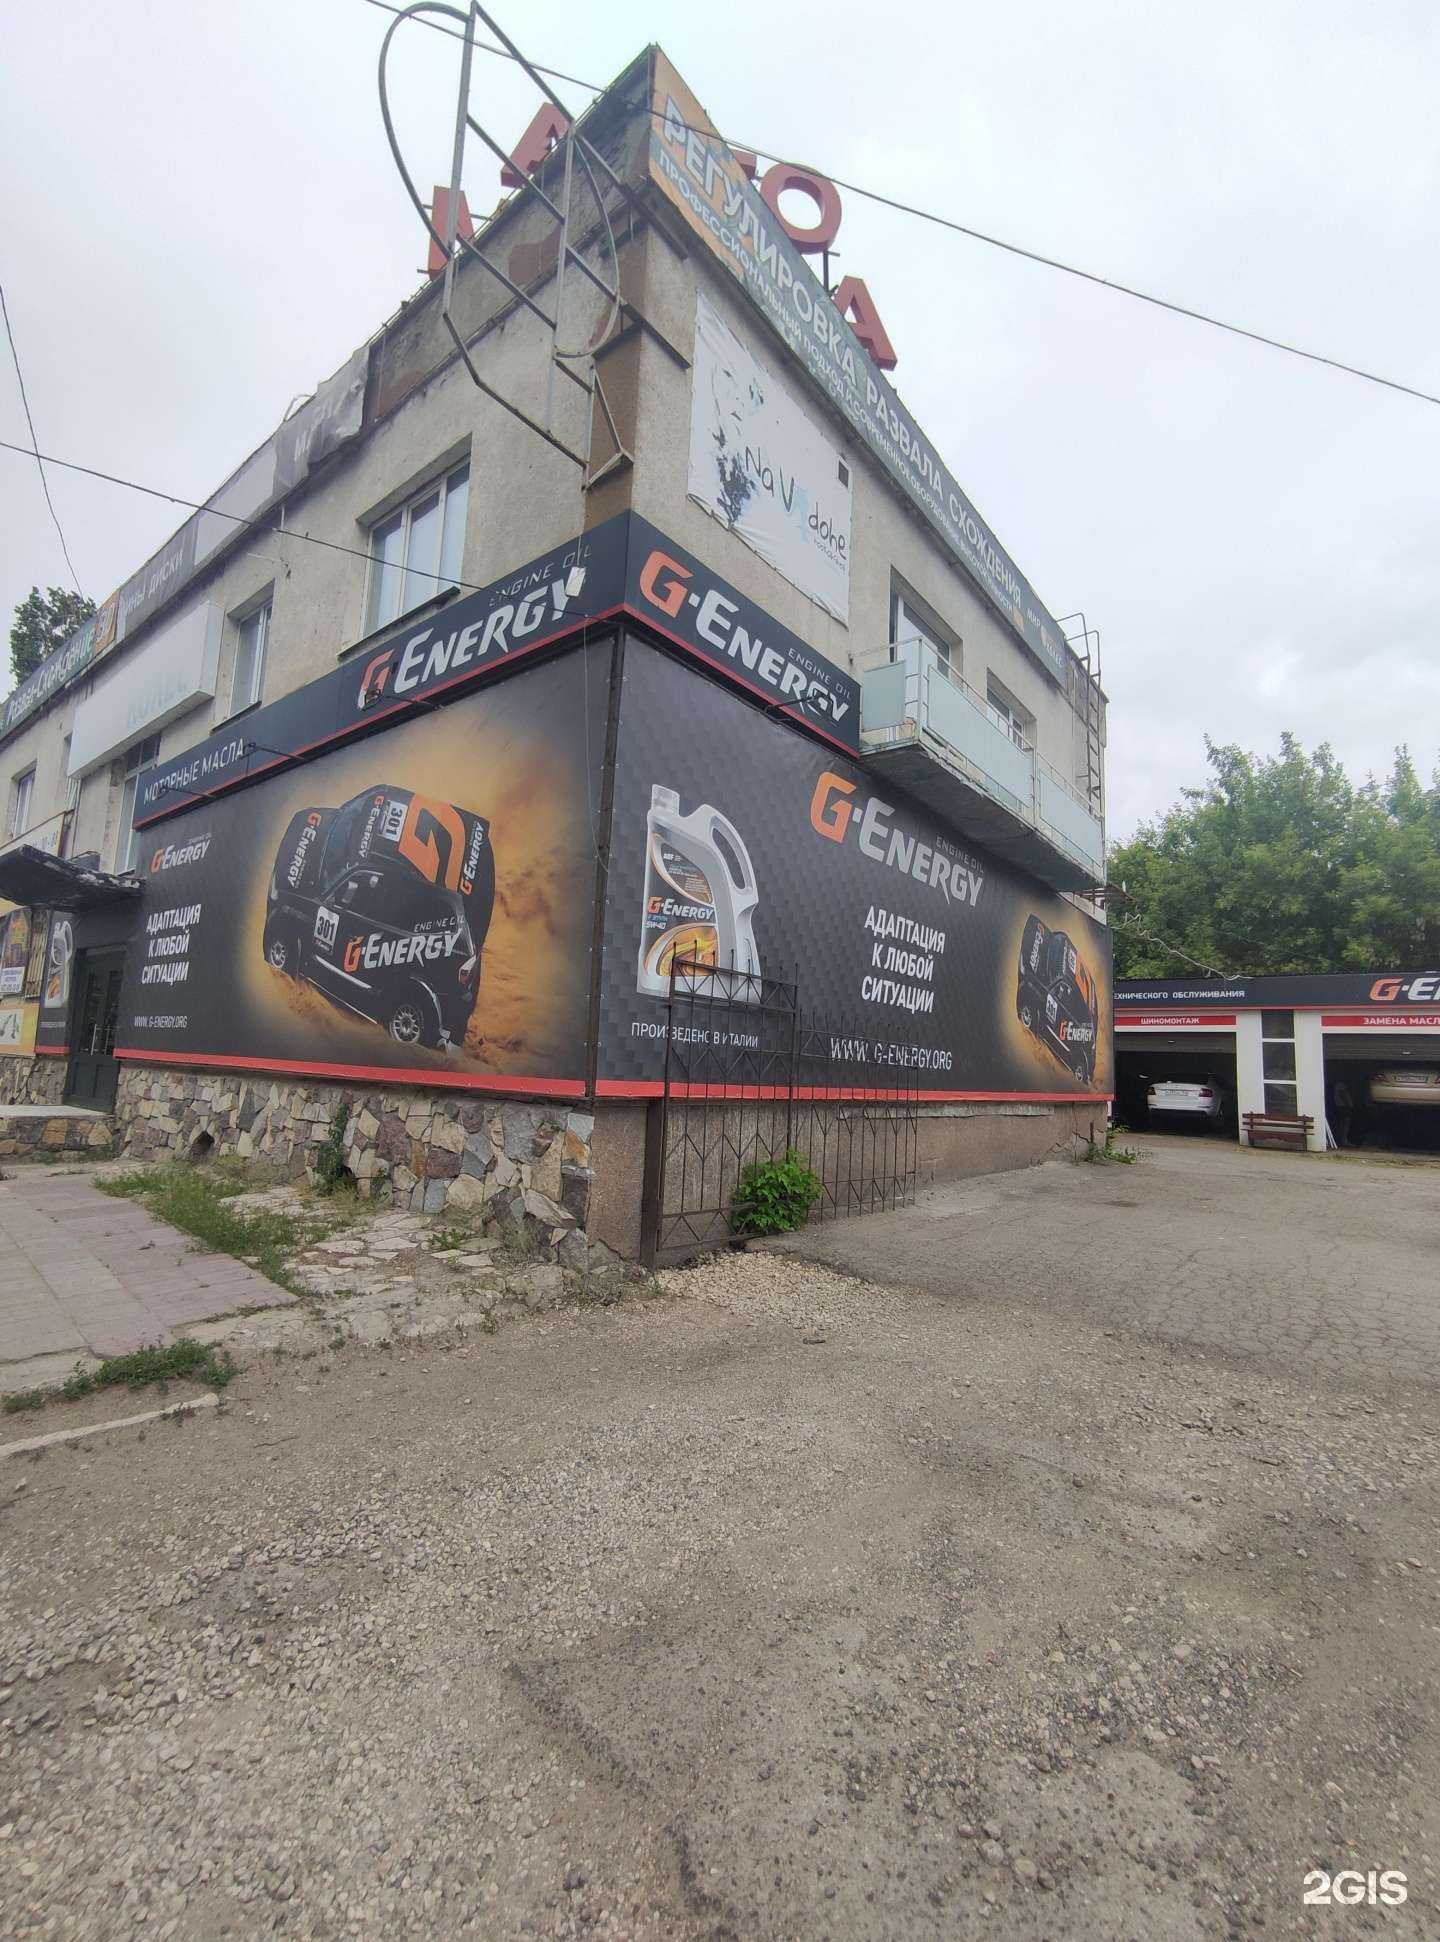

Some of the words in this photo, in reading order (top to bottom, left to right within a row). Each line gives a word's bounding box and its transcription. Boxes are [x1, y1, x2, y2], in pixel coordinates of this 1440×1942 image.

[663, 95, 857, 388] РЕГУЛИРОВКА
[866, 376, 944, 501] РАЗВАЛА
[950, 493, 1021, 608] СХОЖДЕНИЯ
[788, 647, 832, 684] ENGINE
[143, 760, 200, 805] МОТОРНЫЕ
[201, 737, 245, 777] МАСЛА
[145, 904, 202, 935] АДАПТАЦИЯ
[317, 916, 336, 941] 301
[864, 905, 946, 954] АДАПТАЦИЯ
[148, 940, 155, 957] К
[155, 929, 190, 957] ЛЮБОЙ
[141, 961, 190, 986] СИТУАЦИИ
[871, 942, 883, 967] К
[883, 946, 935, 982] ЛЮБОЙ
[861, 975, 935, 1014] СИТУАЦИИ
[1113, 991, 1169, 1000] ЕХНИЧЕСКОГО
[1172, 990, 1245, 1000] ОБСЛУЖИВАНИЯ
[1369, 977, 1440, 1001] G-E
[1140, 1016, 1200, 1025] ШИНОМОНТАЖ
[1363, 1016, 1407, 1025] ЗАМЕНА
[631, 1022, 710, 1044] ПРОИВЕДЕНО
[713, 1031, 720, 1044] В
[722, 1032, 758, 1048] ИТАЛИИ
